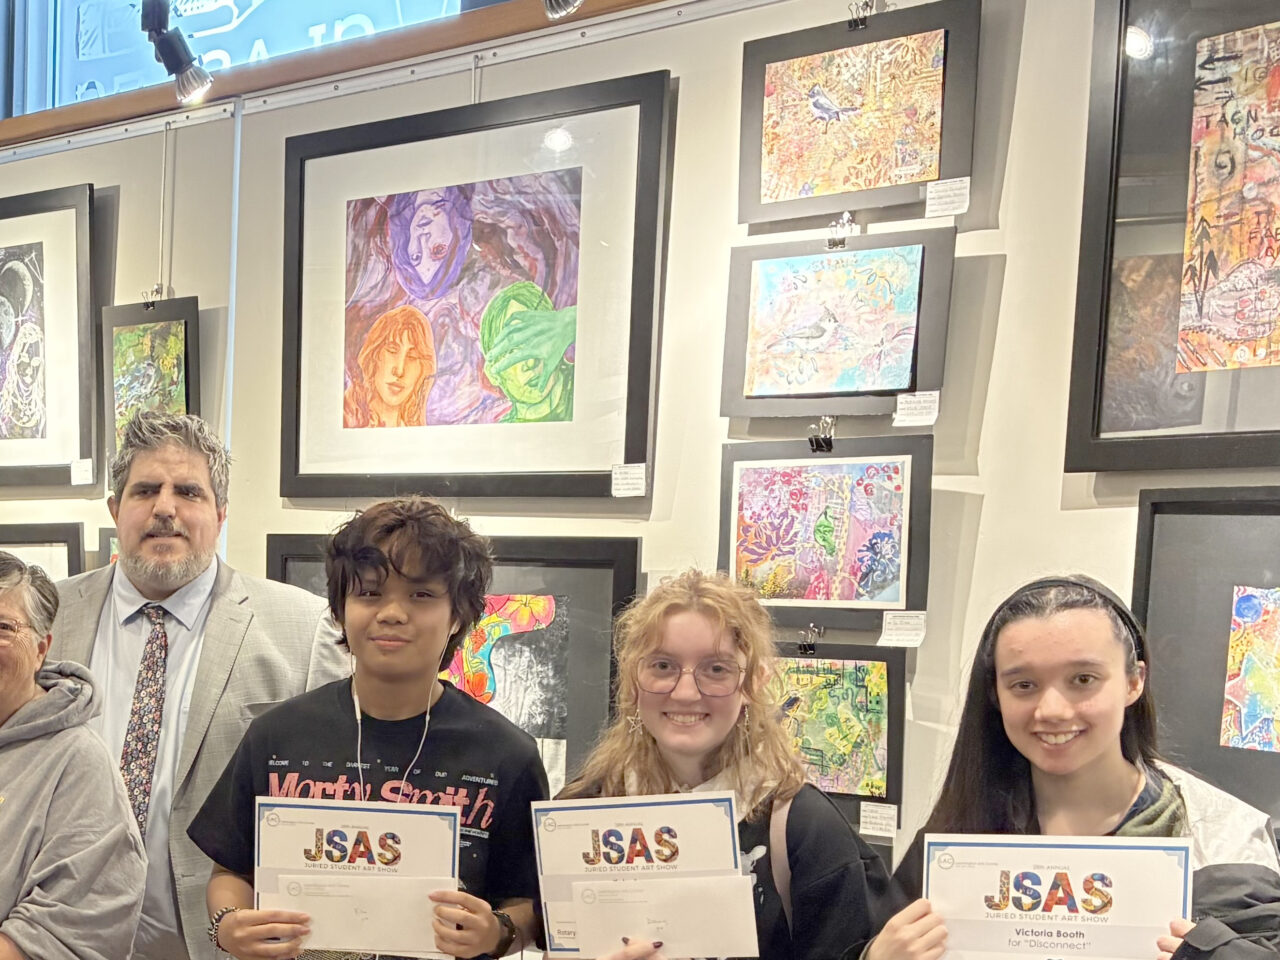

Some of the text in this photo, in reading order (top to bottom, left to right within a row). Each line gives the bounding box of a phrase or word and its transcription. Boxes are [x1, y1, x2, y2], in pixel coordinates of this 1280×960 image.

[304, 828, 401, 866] JSAS
[582, 826, 679, 865] JSAS
[984, 870, 1113, 914] JSAS
[985, 912, 1016, 920] JURIED
[1019, 913, 1058, 921] STUDENT
[1008, 938, 1091, 950] for "Disconnect"
[1015, 928, 1085, 939] Victoria Booth
